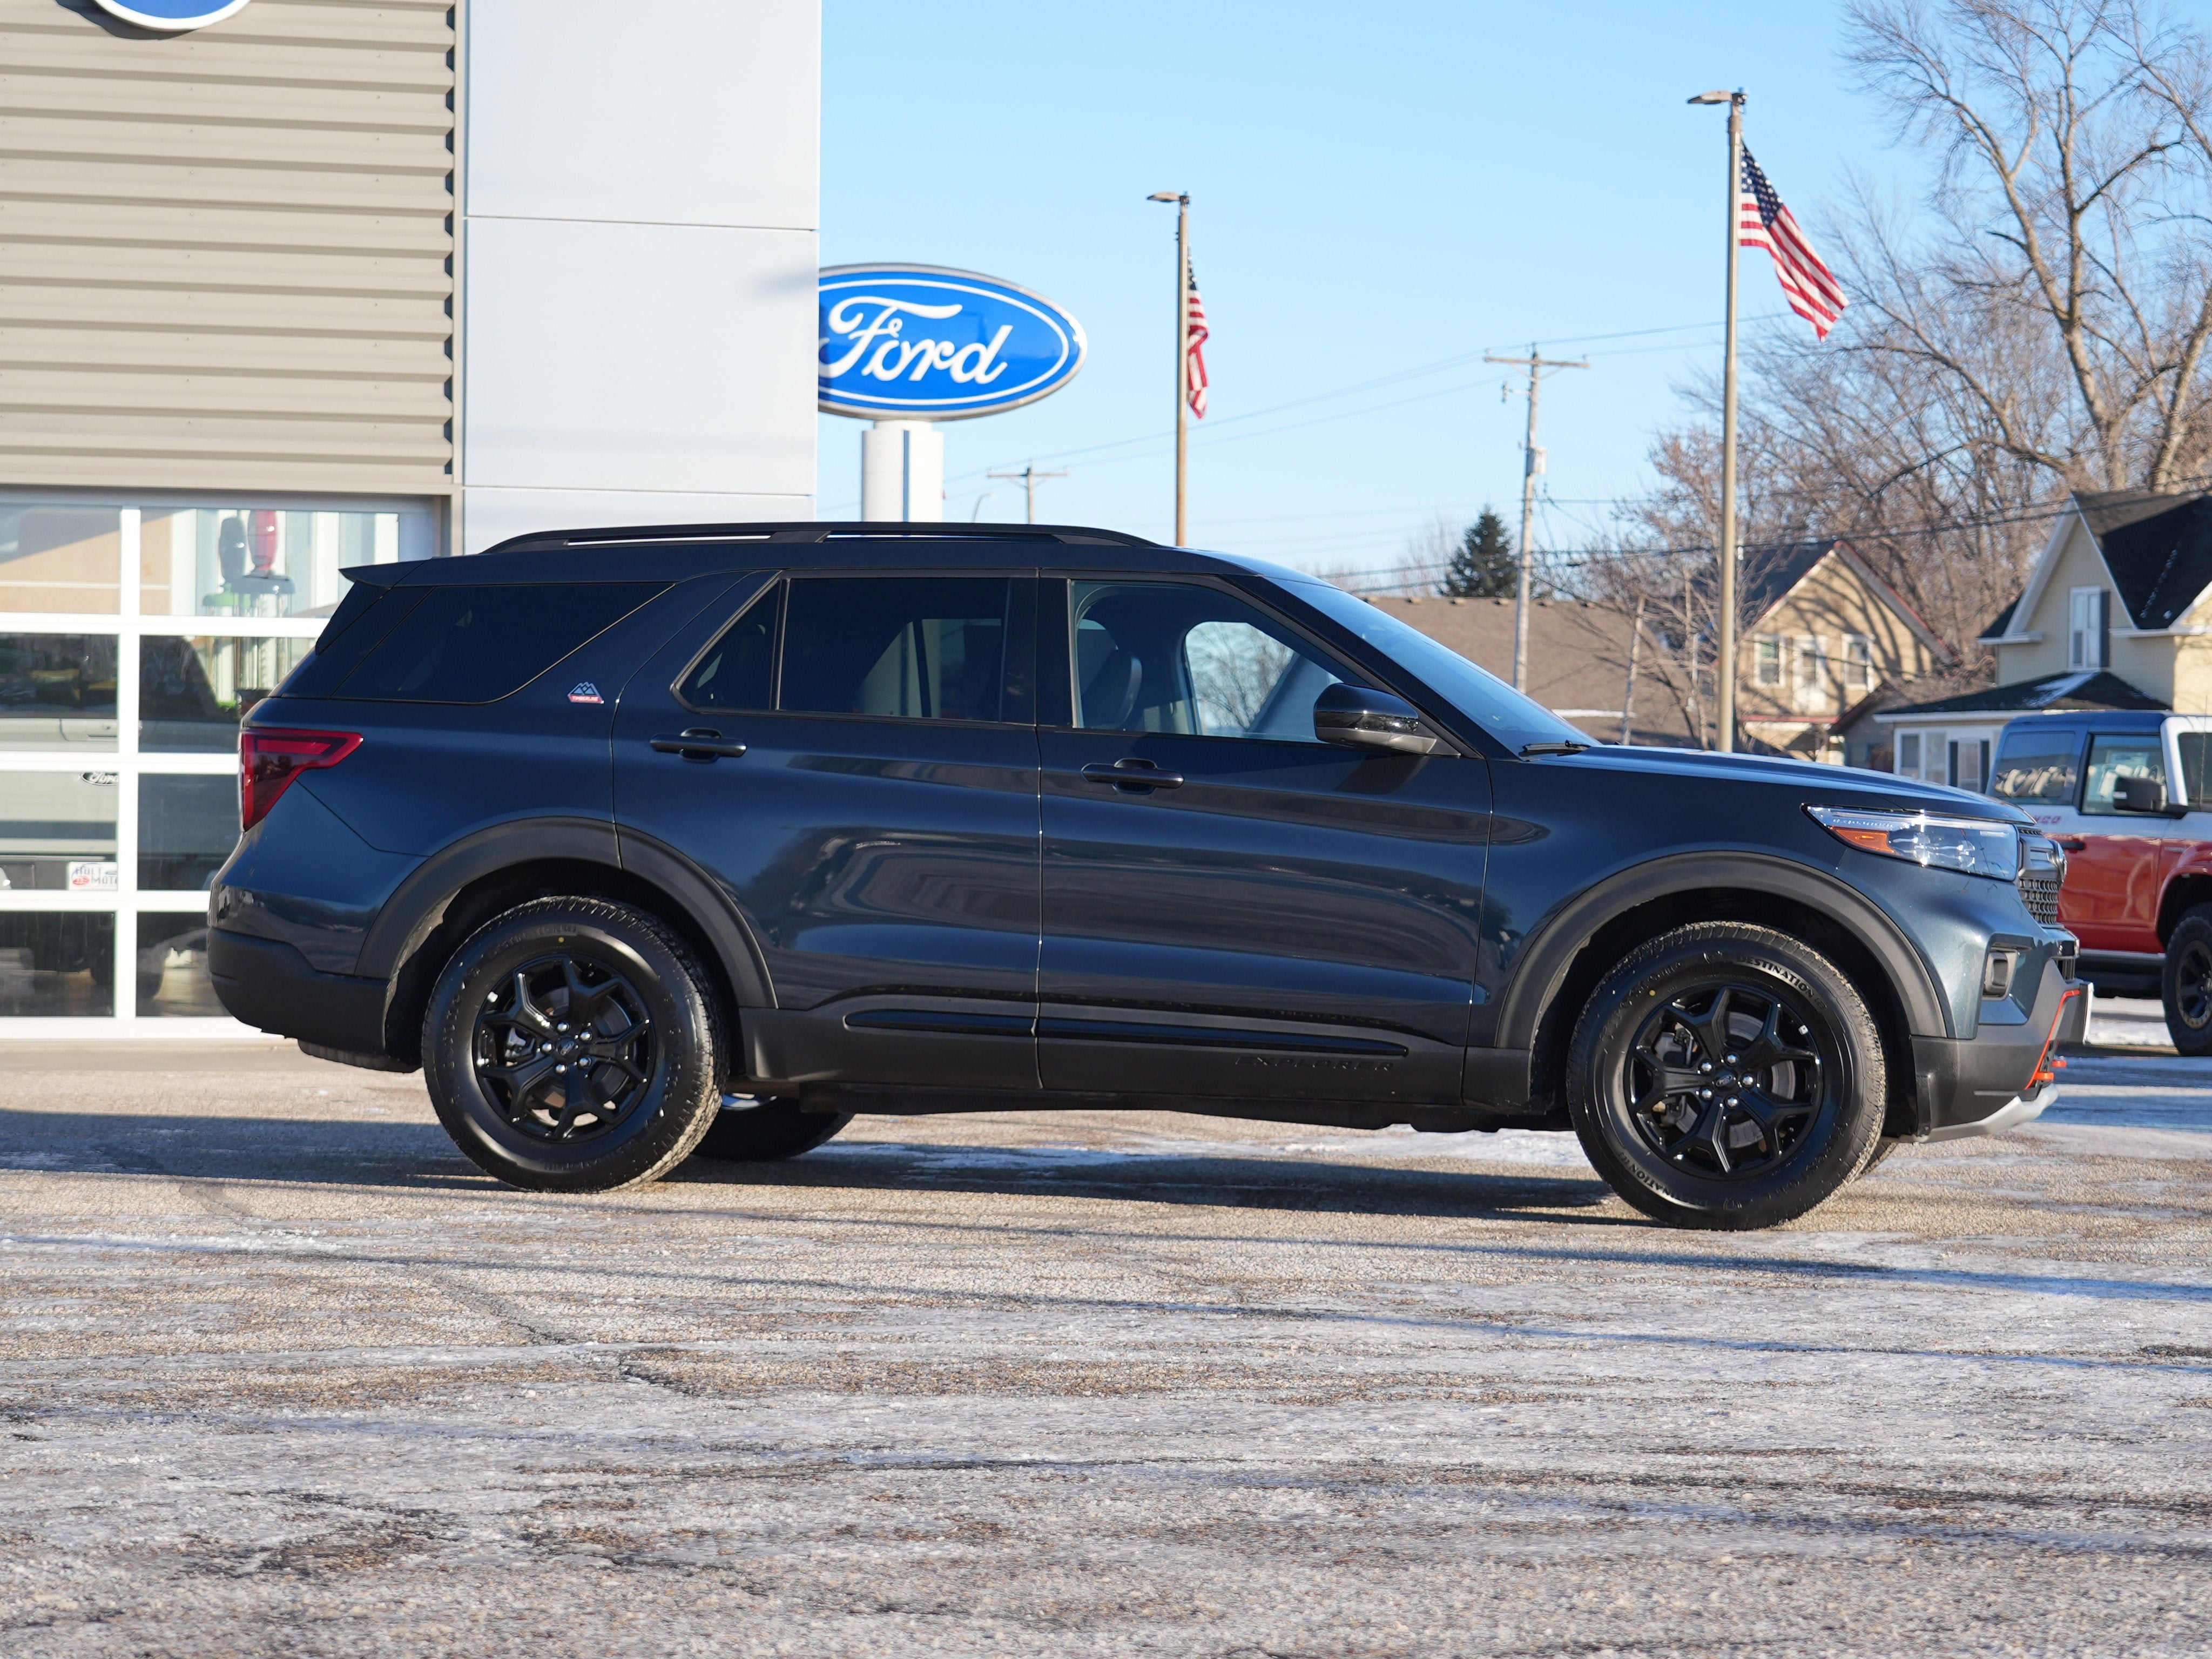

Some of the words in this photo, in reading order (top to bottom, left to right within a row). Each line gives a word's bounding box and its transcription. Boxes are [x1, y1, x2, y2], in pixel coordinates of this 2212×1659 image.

[819, 296, 1013, 385] Ford
[75, 866, 102, 875] HOLT
[1737, 955, 1815, 998] DESTINATION
[1235, 1056, 1394, 1071] EXPLORER
